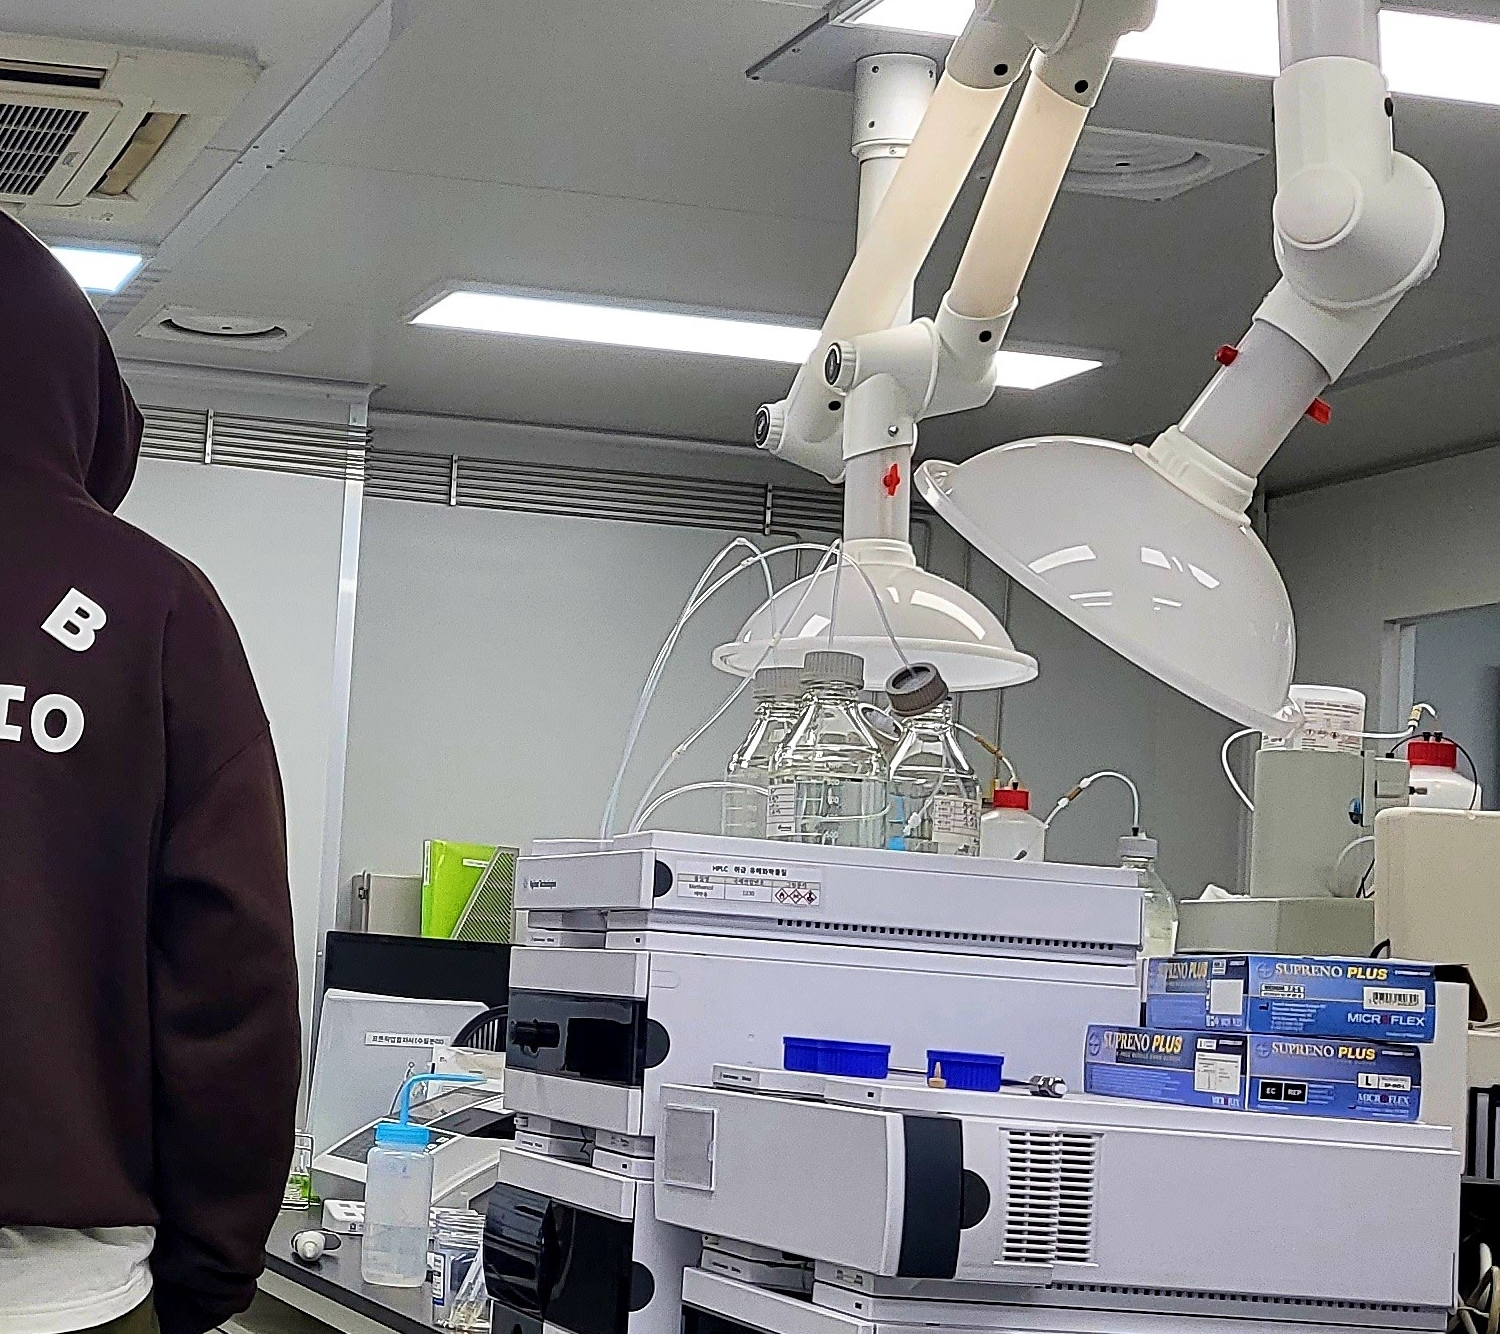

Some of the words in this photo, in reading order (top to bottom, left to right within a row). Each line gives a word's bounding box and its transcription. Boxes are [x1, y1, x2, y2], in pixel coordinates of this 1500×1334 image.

[1275, 963, 1343, 978] SUPRENO
[1346, 966, 1388, 980] PLUS
[1103, 1031, 1151, 1053] SUPRENO
[1152, 1034, 1183, 1055] PLUS
[1272, 1042, 1335, 1058] SUPRENO
[1338, 1046, 1376, 1061] PLUS
